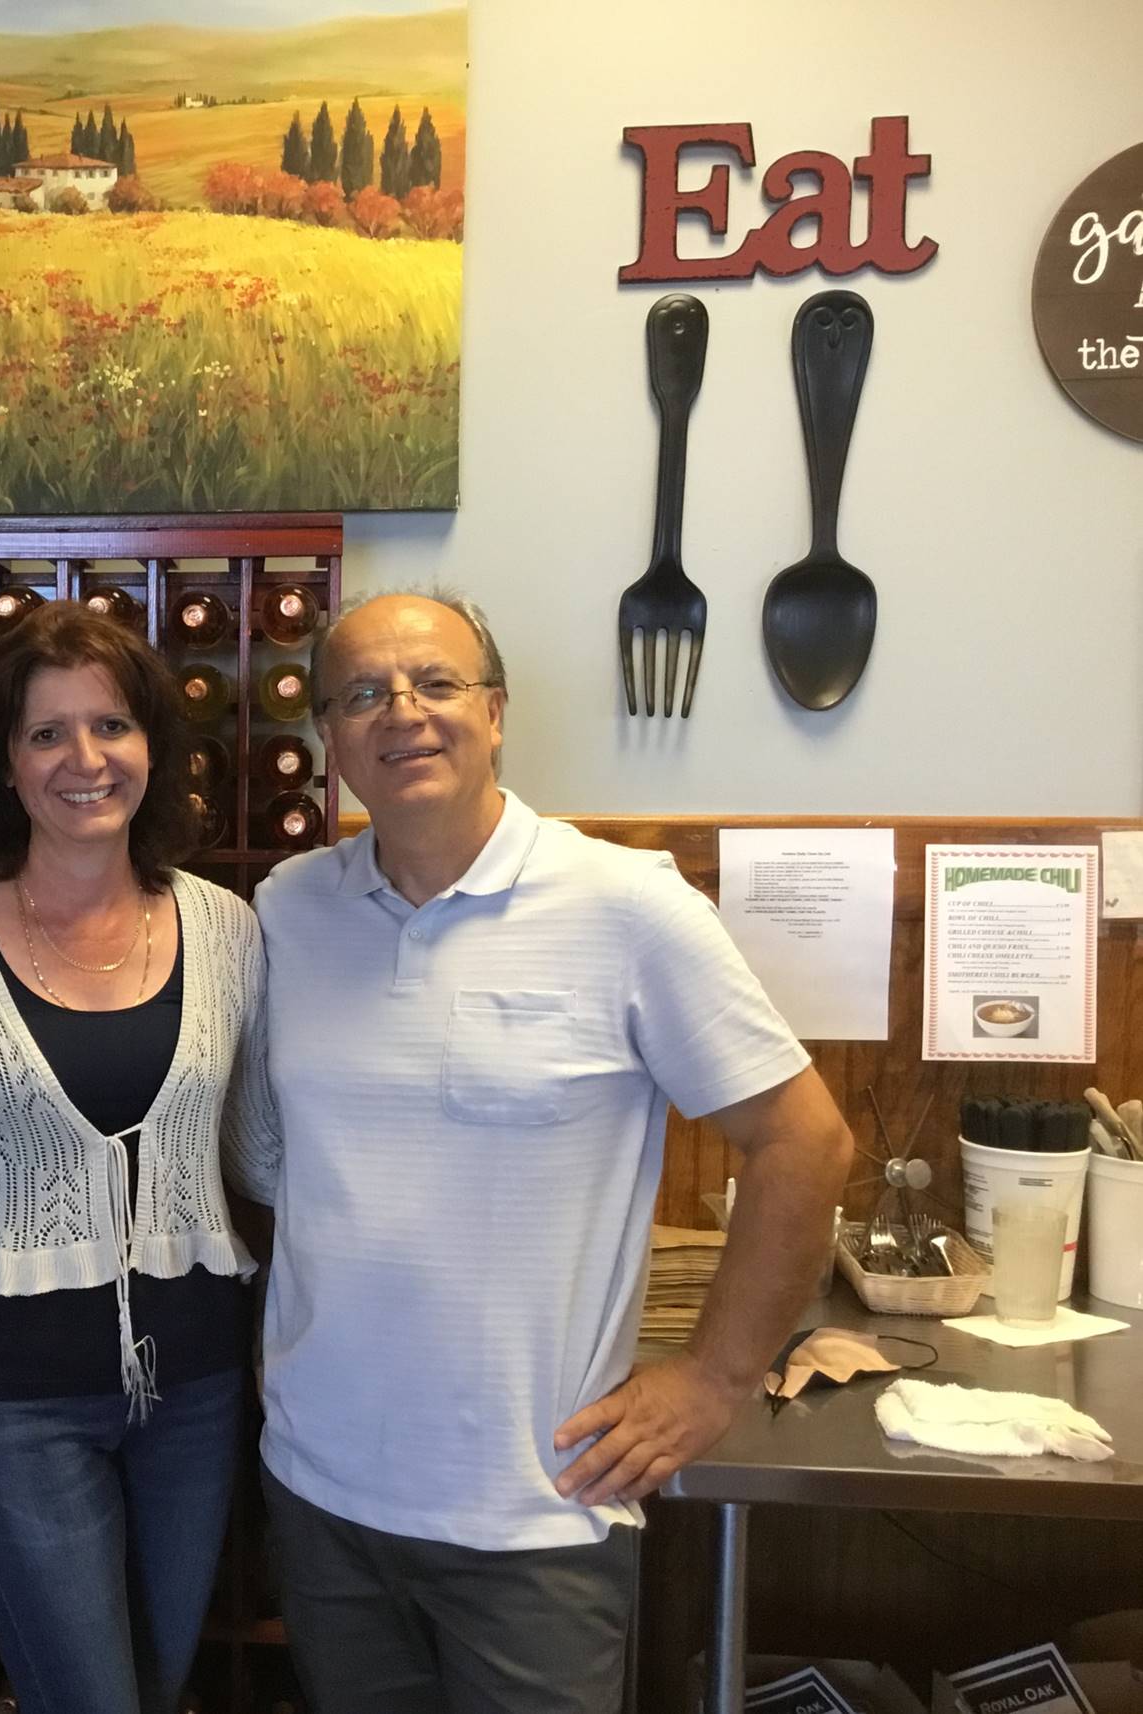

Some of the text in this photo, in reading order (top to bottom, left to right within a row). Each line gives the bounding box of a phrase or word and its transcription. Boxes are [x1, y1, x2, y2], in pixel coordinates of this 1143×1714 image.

[618, 115, 939, 284] Eat
[944, 867, 1082, 893] HOMEMADE CHILI
[1024, 1683, 1056, 1702] OAK
